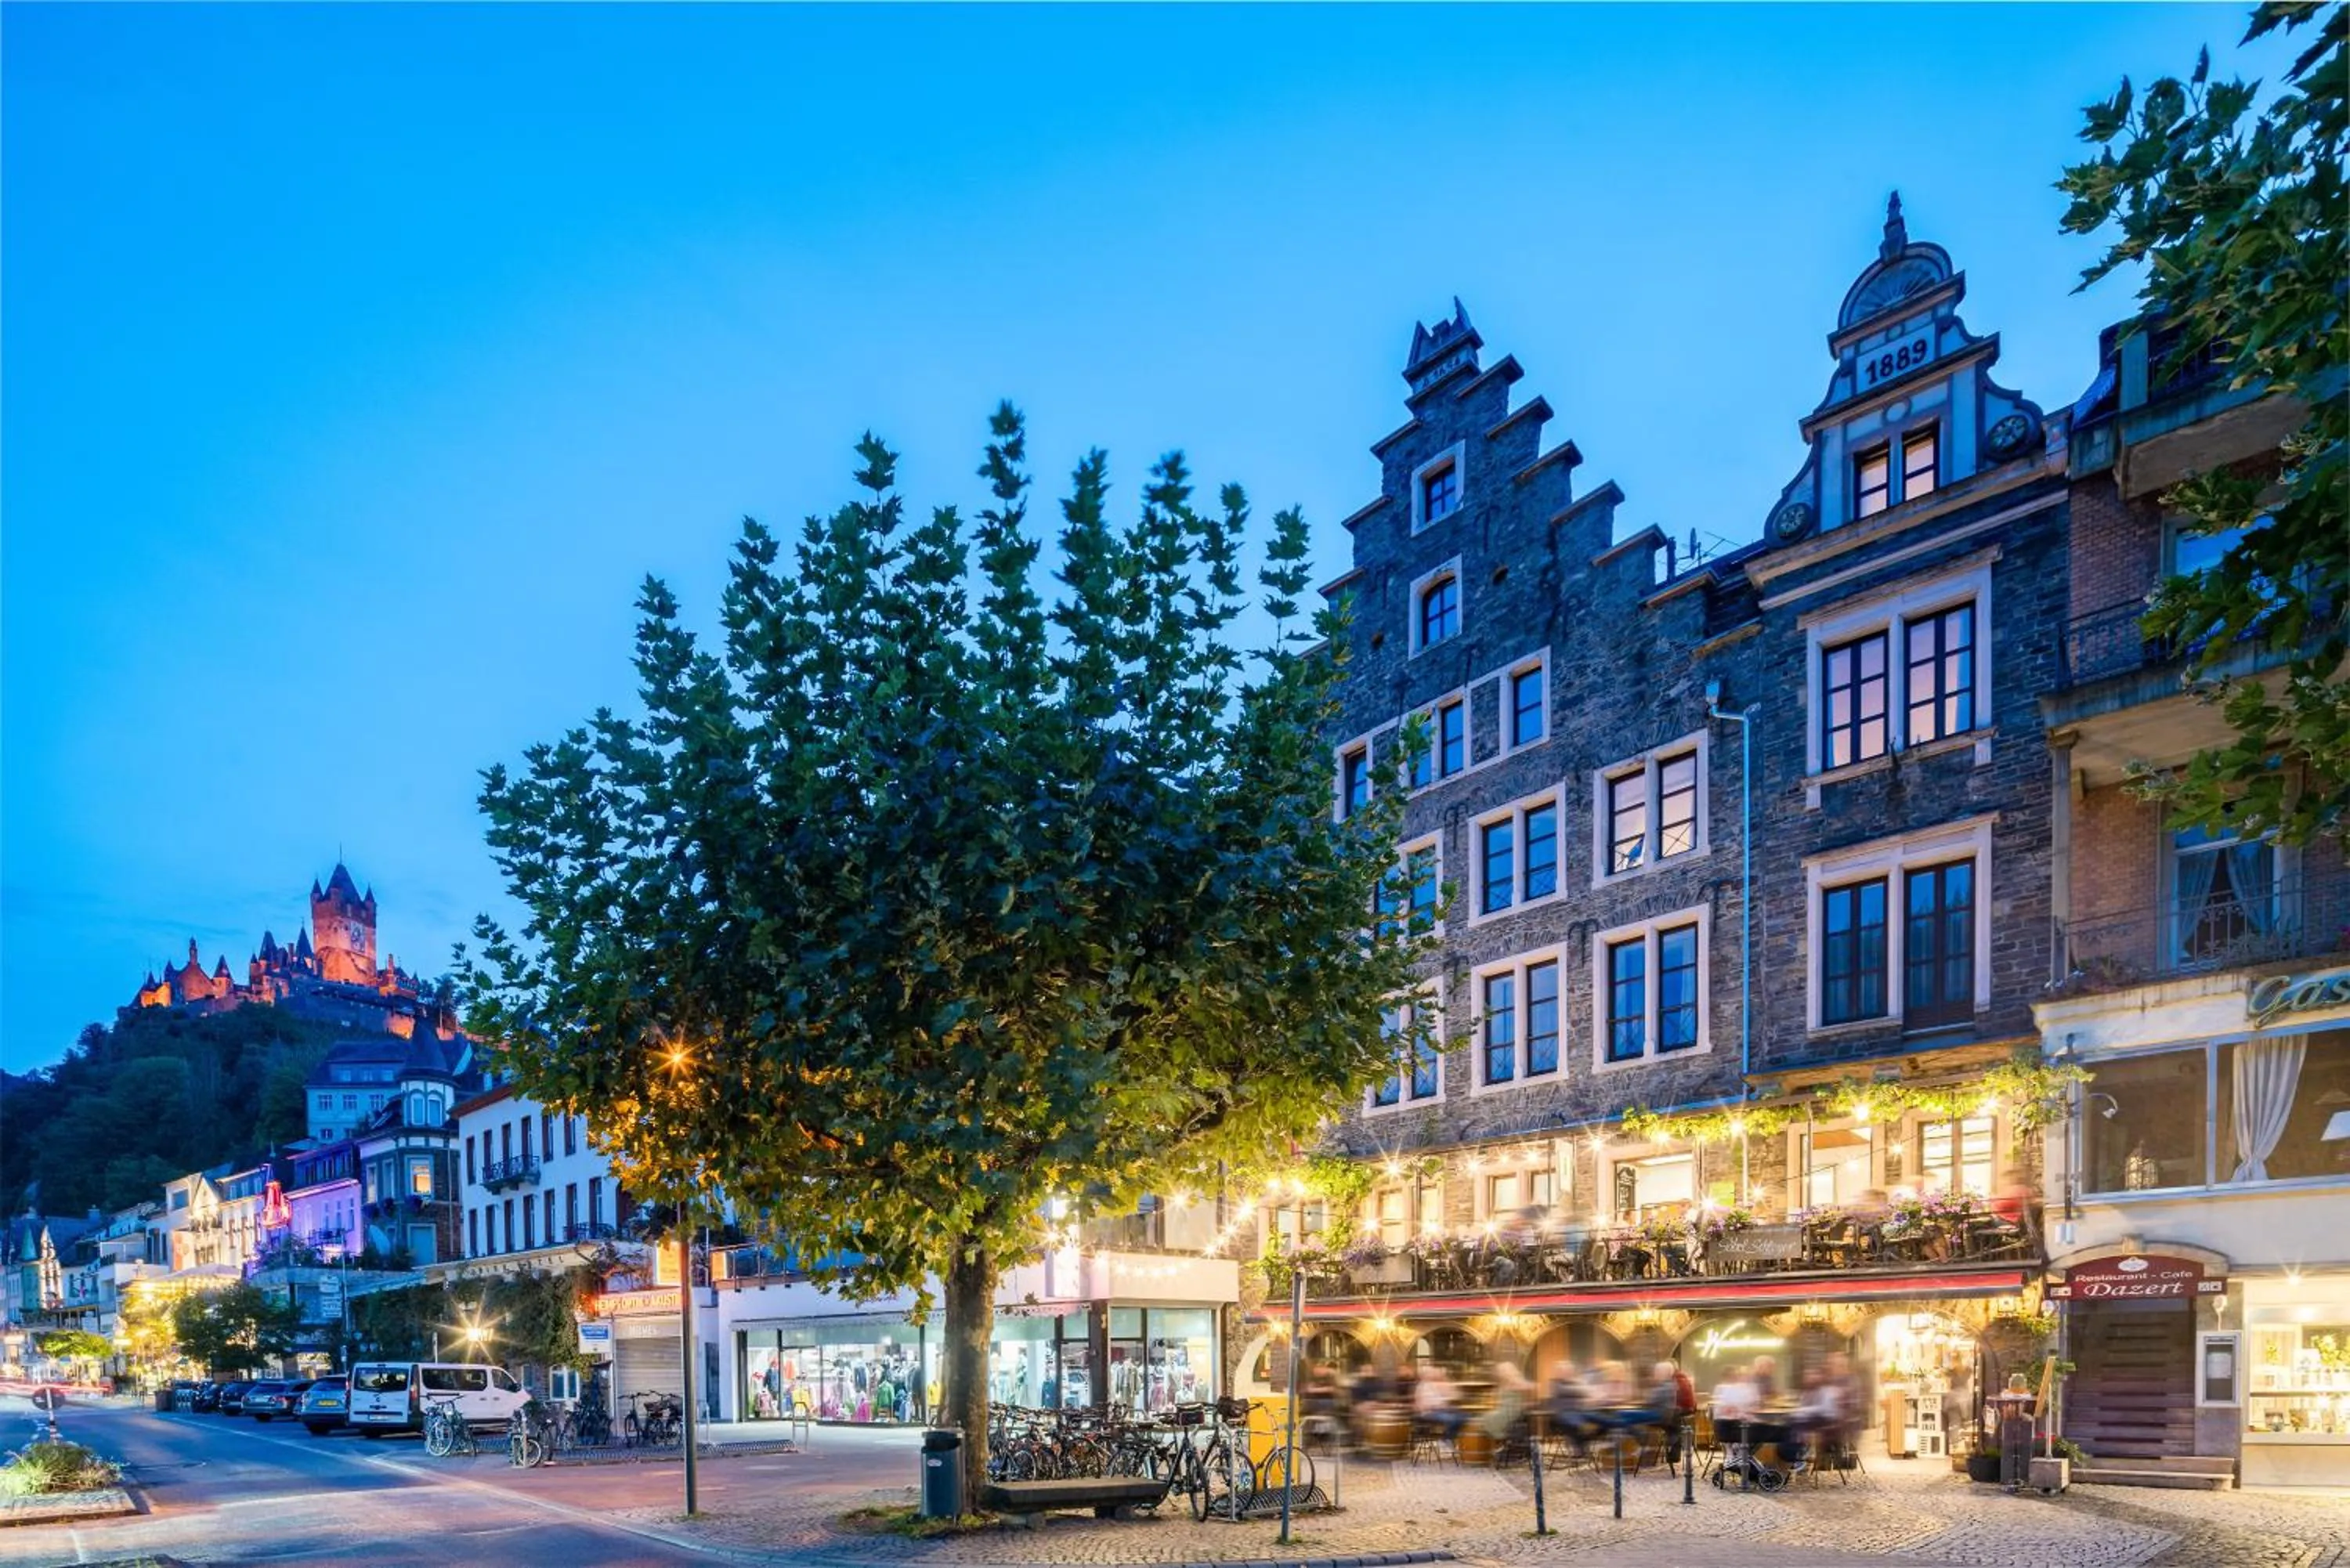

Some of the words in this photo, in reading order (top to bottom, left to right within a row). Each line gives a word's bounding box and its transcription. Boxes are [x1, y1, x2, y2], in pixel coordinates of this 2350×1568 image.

[1866, 338, 1927, 385] 1889
[2076, 1273, 2147, 1282] Restaurant
[2084, 1281, 2184, 1297] Dazert
